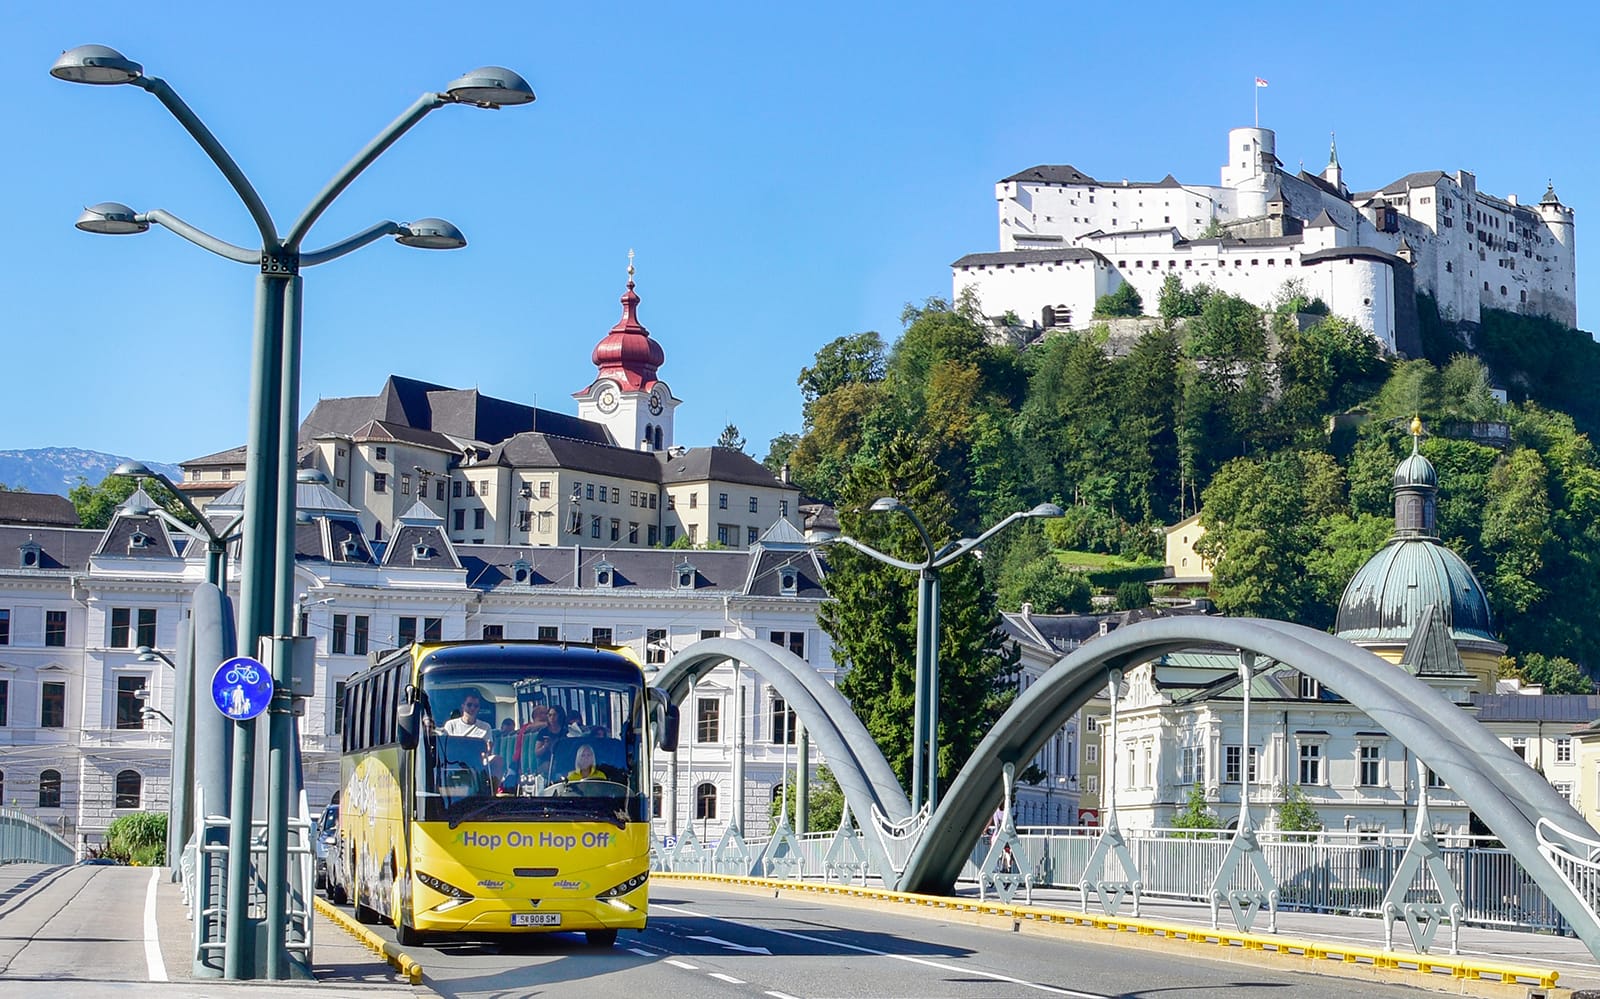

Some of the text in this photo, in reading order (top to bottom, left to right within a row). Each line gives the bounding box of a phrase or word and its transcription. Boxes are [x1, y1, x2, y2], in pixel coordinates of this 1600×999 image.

[464, 831, 610, 851] Hop On Hop Off
[530, 915, 544, 923] 908
[546, 915, 556, 923] SM
